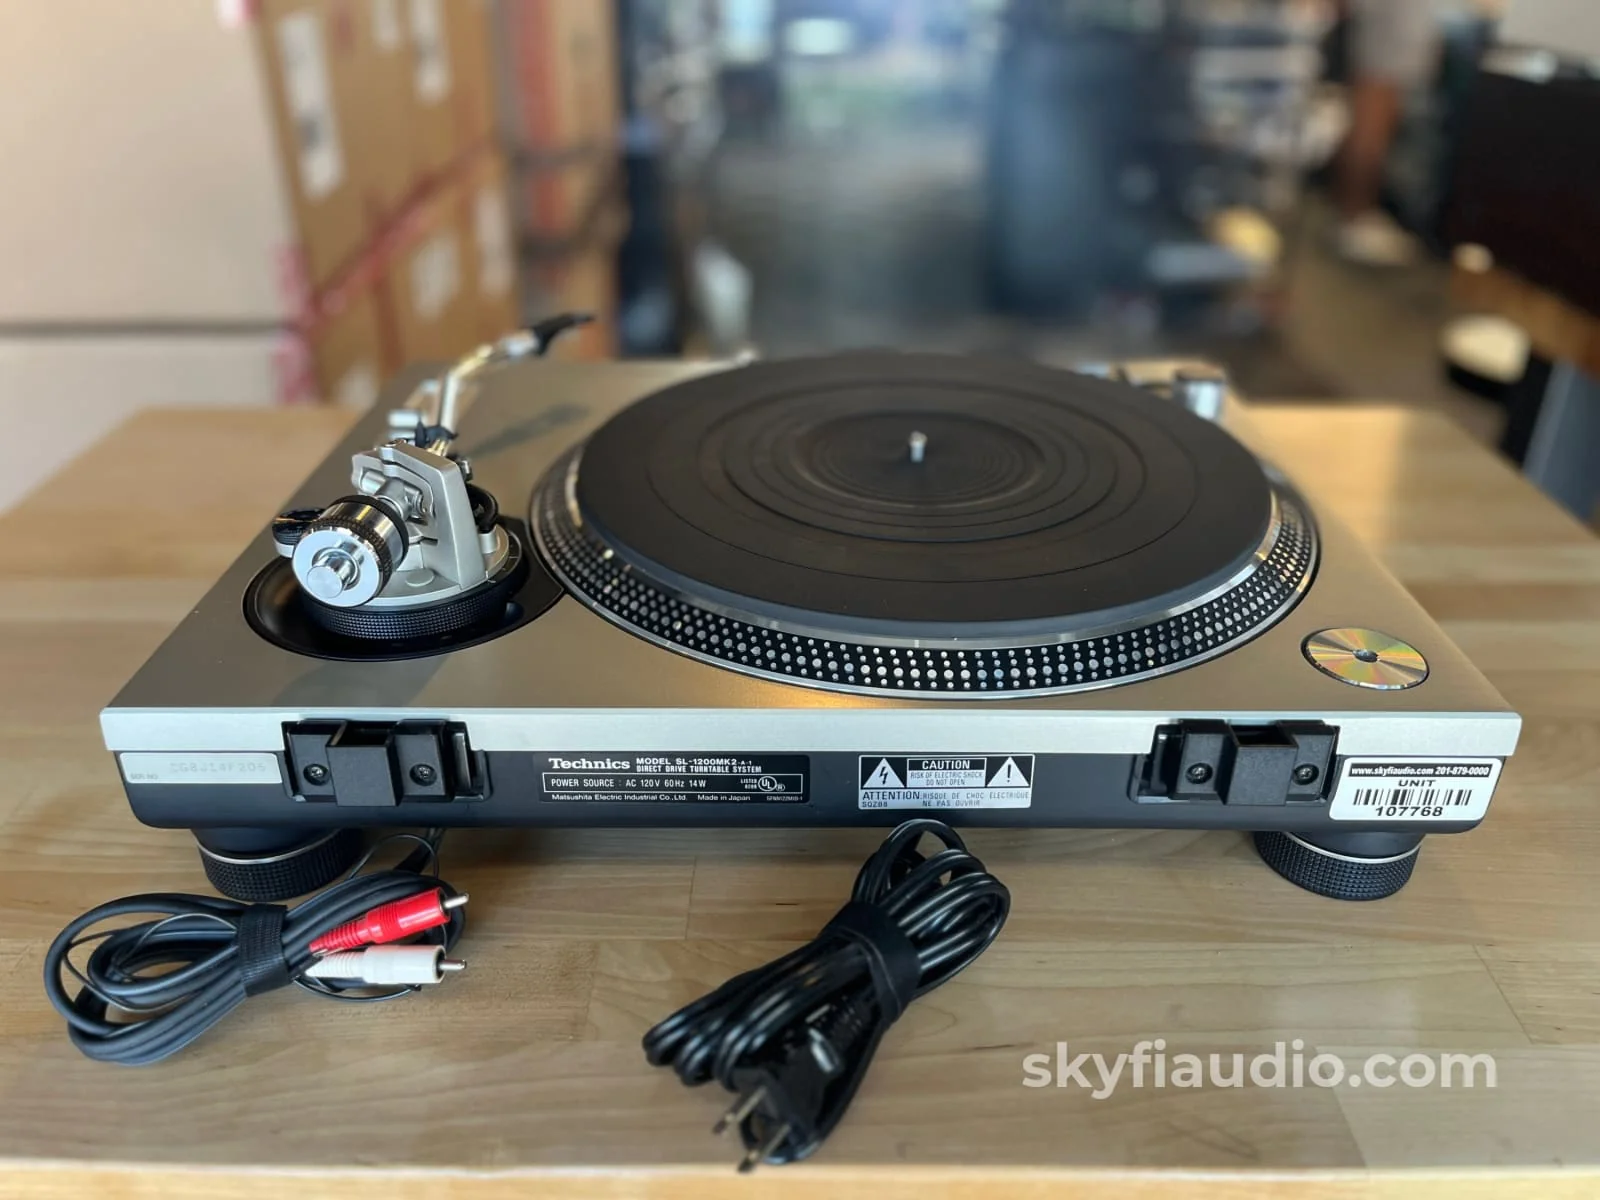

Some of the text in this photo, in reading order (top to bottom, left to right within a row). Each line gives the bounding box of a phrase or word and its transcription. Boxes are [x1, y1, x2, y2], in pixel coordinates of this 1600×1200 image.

[548, 758, 630, 769] Technics
[636, 757, 671, 765] MODEL
[922, 760, 970, 769] CAUTION
[1351, 767, 1490, 776] www.skyfiaudio.com 201-879-0000
[551, 779, 579, 787] POWER
[583, 779, 614, 787] SOURCE
[626, 779, 636, 787] AC
[923, 792, 947, 800] RISQUE
[1376, 806, 1443, 817] 107768
